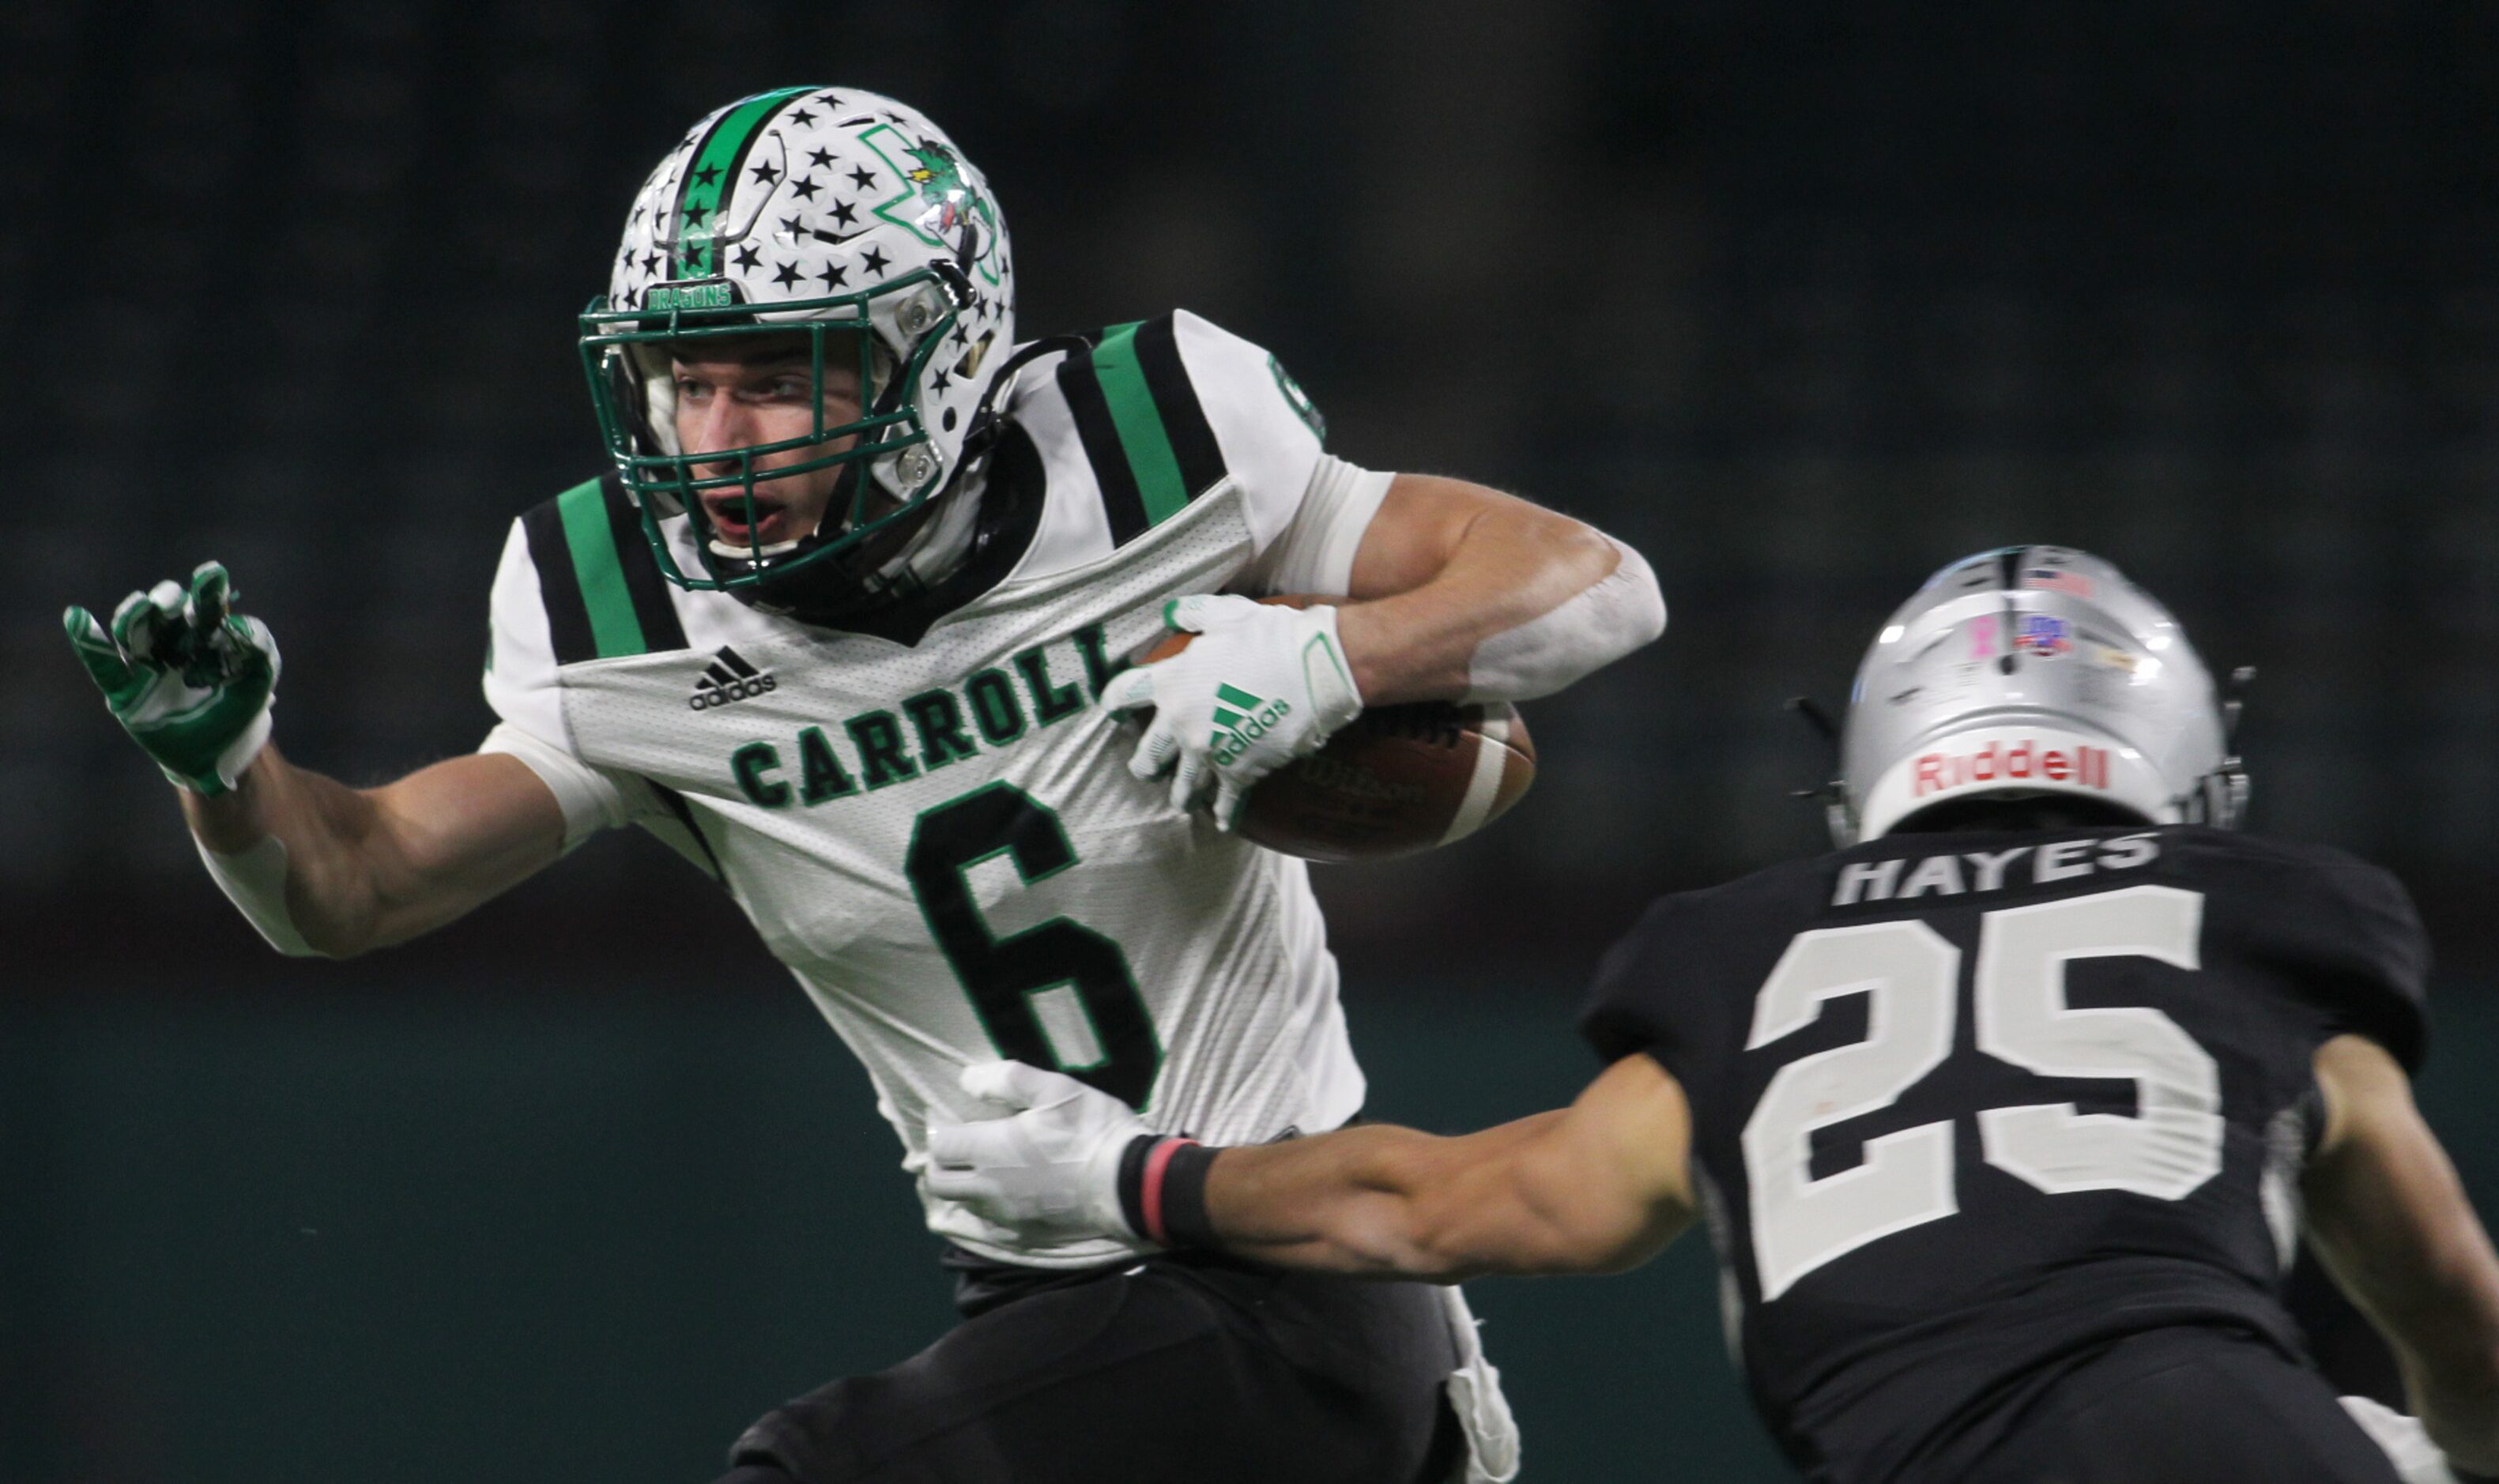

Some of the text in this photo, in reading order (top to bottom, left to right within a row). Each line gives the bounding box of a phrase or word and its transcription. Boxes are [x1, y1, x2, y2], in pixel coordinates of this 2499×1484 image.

[647, 284, 732, 311] DRAGONS
[689, 675, 777, 710] adidas
[730, 621, 1133, 808] CARROLL
[1214, 699, 1291, 766] adidas
[1911, 739, 2112, 797] Riddell
[1830, 831, 2163, 906] HAYES
[903, 778, 1167, 1115] 6
[1740, 883, 2226, 1304] 25
